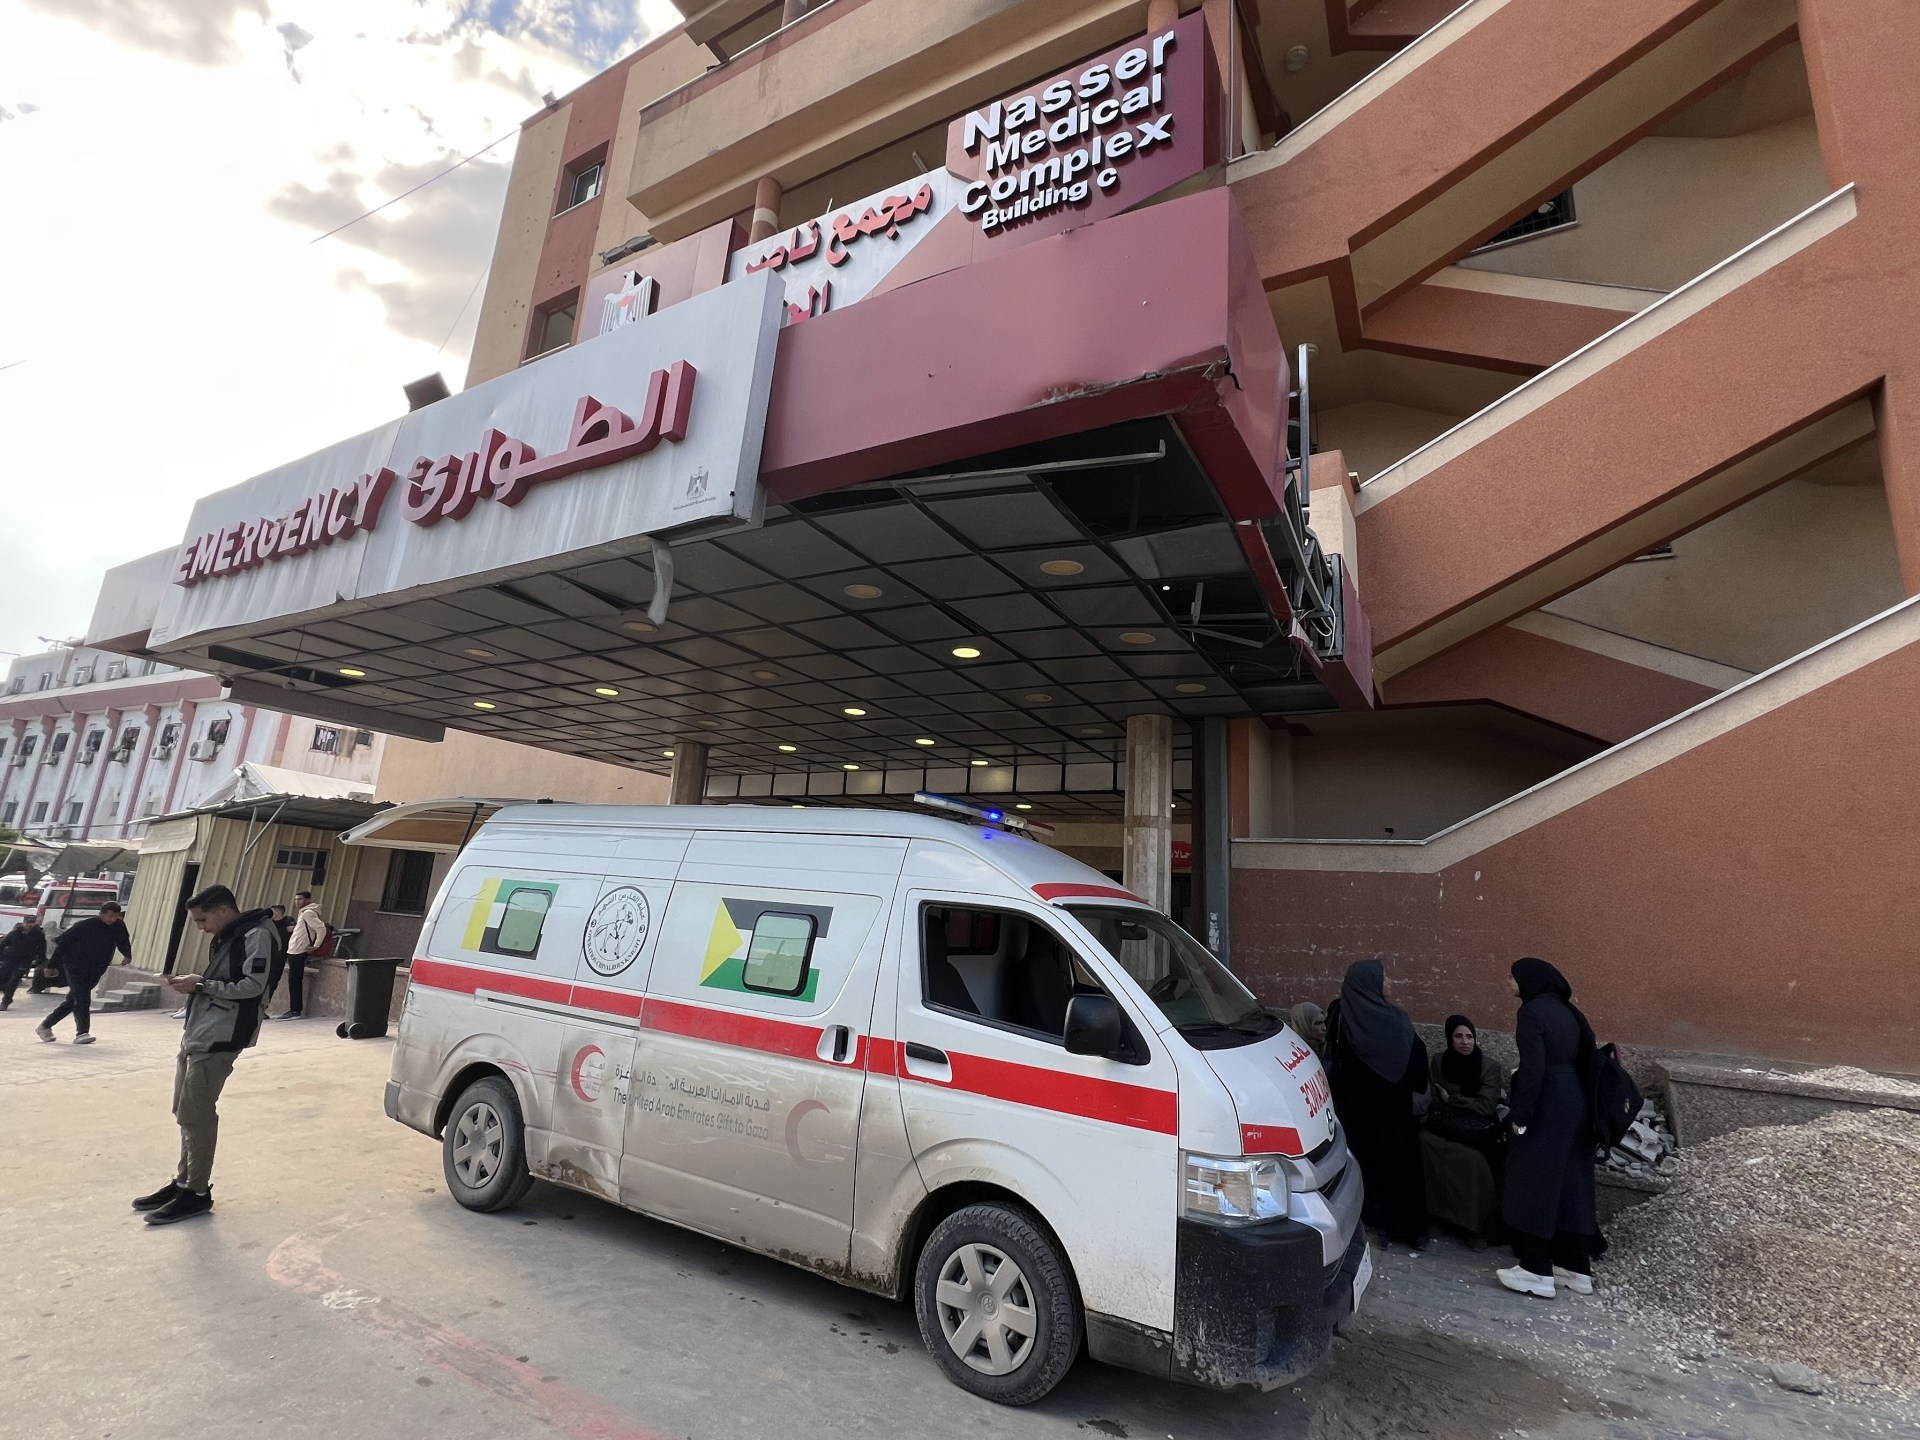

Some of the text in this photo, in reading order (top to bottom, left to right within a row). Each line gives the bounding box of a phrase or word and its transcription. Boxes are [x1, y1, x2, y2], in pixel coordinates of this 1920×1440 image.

[963, 30, 1175, 149] Nasser
[985, 72, 1162, 172] Medical
[958, 112, 1173, 213] Complex
[825, 182, 935, 269] مجمع
[981, 179, 1088, 230] Building
[401, 359, 697, 528] الطوارئ
[173, 466, 396, 587] EMERGENCY
[1171, 849, 1191, 859] حالا
[615, 1063, 630, 1080] غزة
[647, 1071, 679, 1091] المدة
[680, 1077, 710, 1098] العربية
[613, 1086, 628, 1105] The
[655, 1097, 676, 1117] Arab
[677, 1102, 715, 1127] Emirates
[716, 1112, 733, 1132] Gift
[734, 1118, 744, 1134] to
[745, 1118, 769, 1140] Gaza
[745, 1091, 771, 1112] هدية
